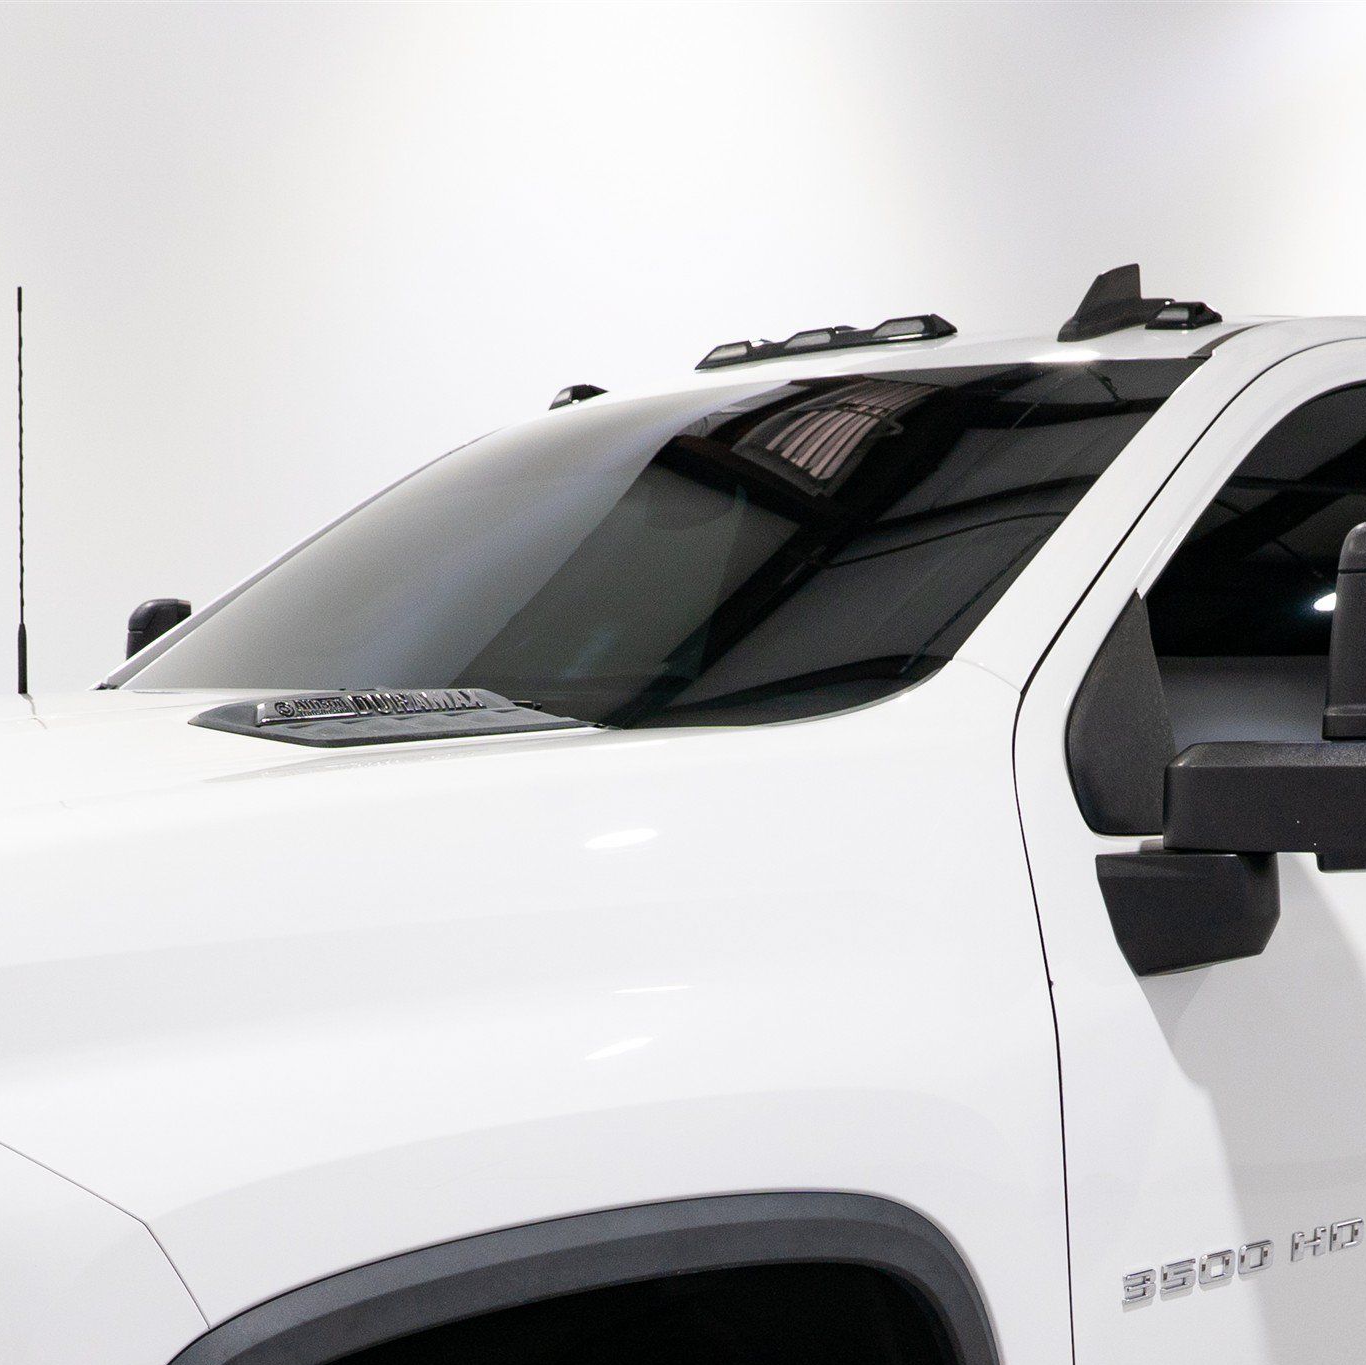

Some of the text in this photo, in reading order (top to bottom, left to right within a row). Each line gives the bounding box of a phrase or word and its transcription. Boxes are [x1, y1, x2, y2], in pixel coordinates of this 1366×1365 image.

[348, 689, 486, 717] DURAMAX
[1122, 1216, 1364, 1303] 3500 HD
